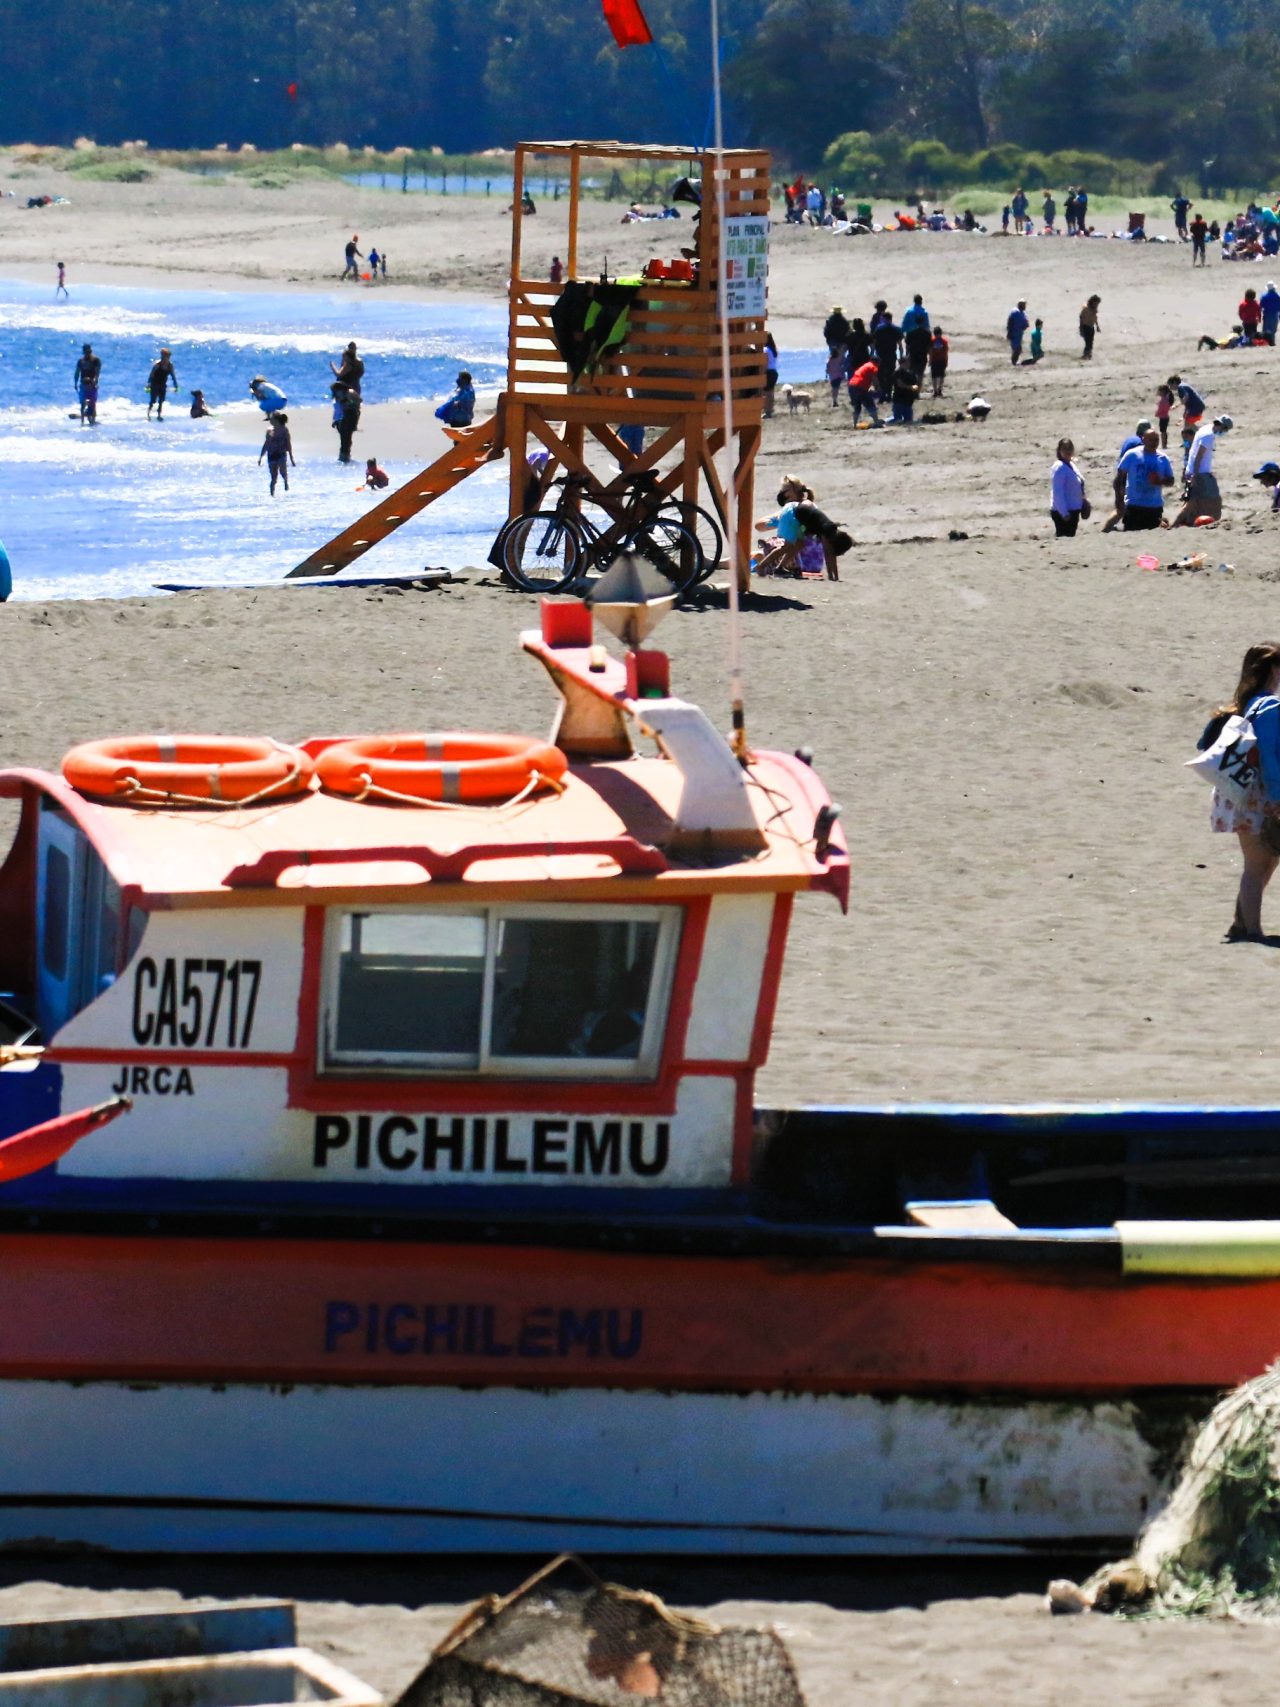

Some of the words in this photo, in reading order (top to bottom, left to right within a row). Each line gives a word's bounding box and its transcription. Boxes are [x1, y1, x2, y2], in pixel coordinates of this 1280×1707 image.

[132, 957, 262, 1048] CA5717
[112, 1066, 195, 1096] JRCA
[313, 1115, 671, 1176] PICHILEMU
[323, 1301, 644, 1360] PICHILEMU
